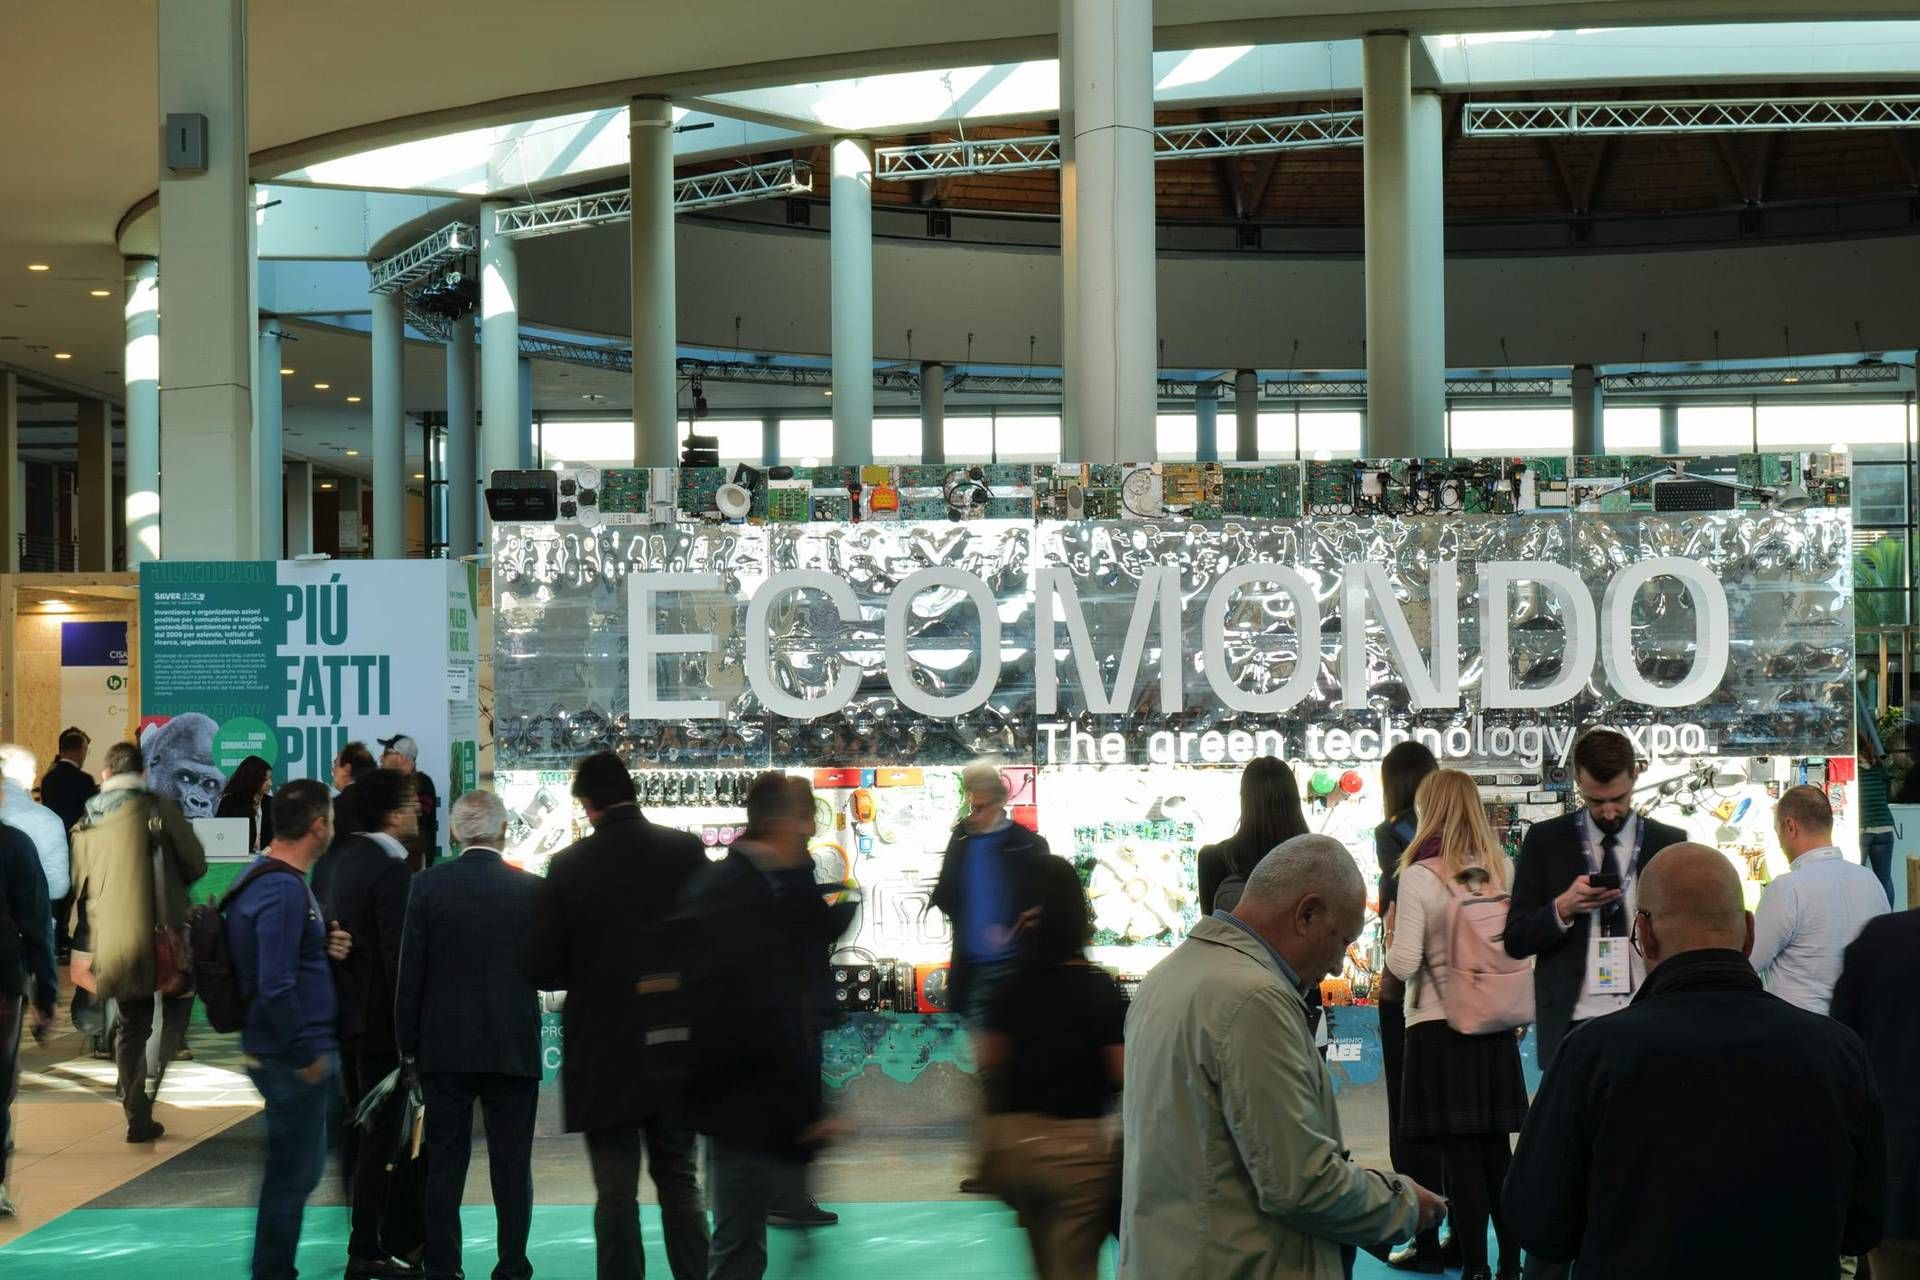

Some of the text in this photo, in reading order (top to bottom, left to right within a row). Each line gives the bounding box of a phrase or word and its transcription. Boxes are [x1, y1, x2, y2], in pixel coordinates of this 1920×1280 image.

[626, 556, 1729, 719] ECOMONDO
[276, 655, 390, 716] FATTI
[1037, 715, 1718, 769] The green technology xpo.
